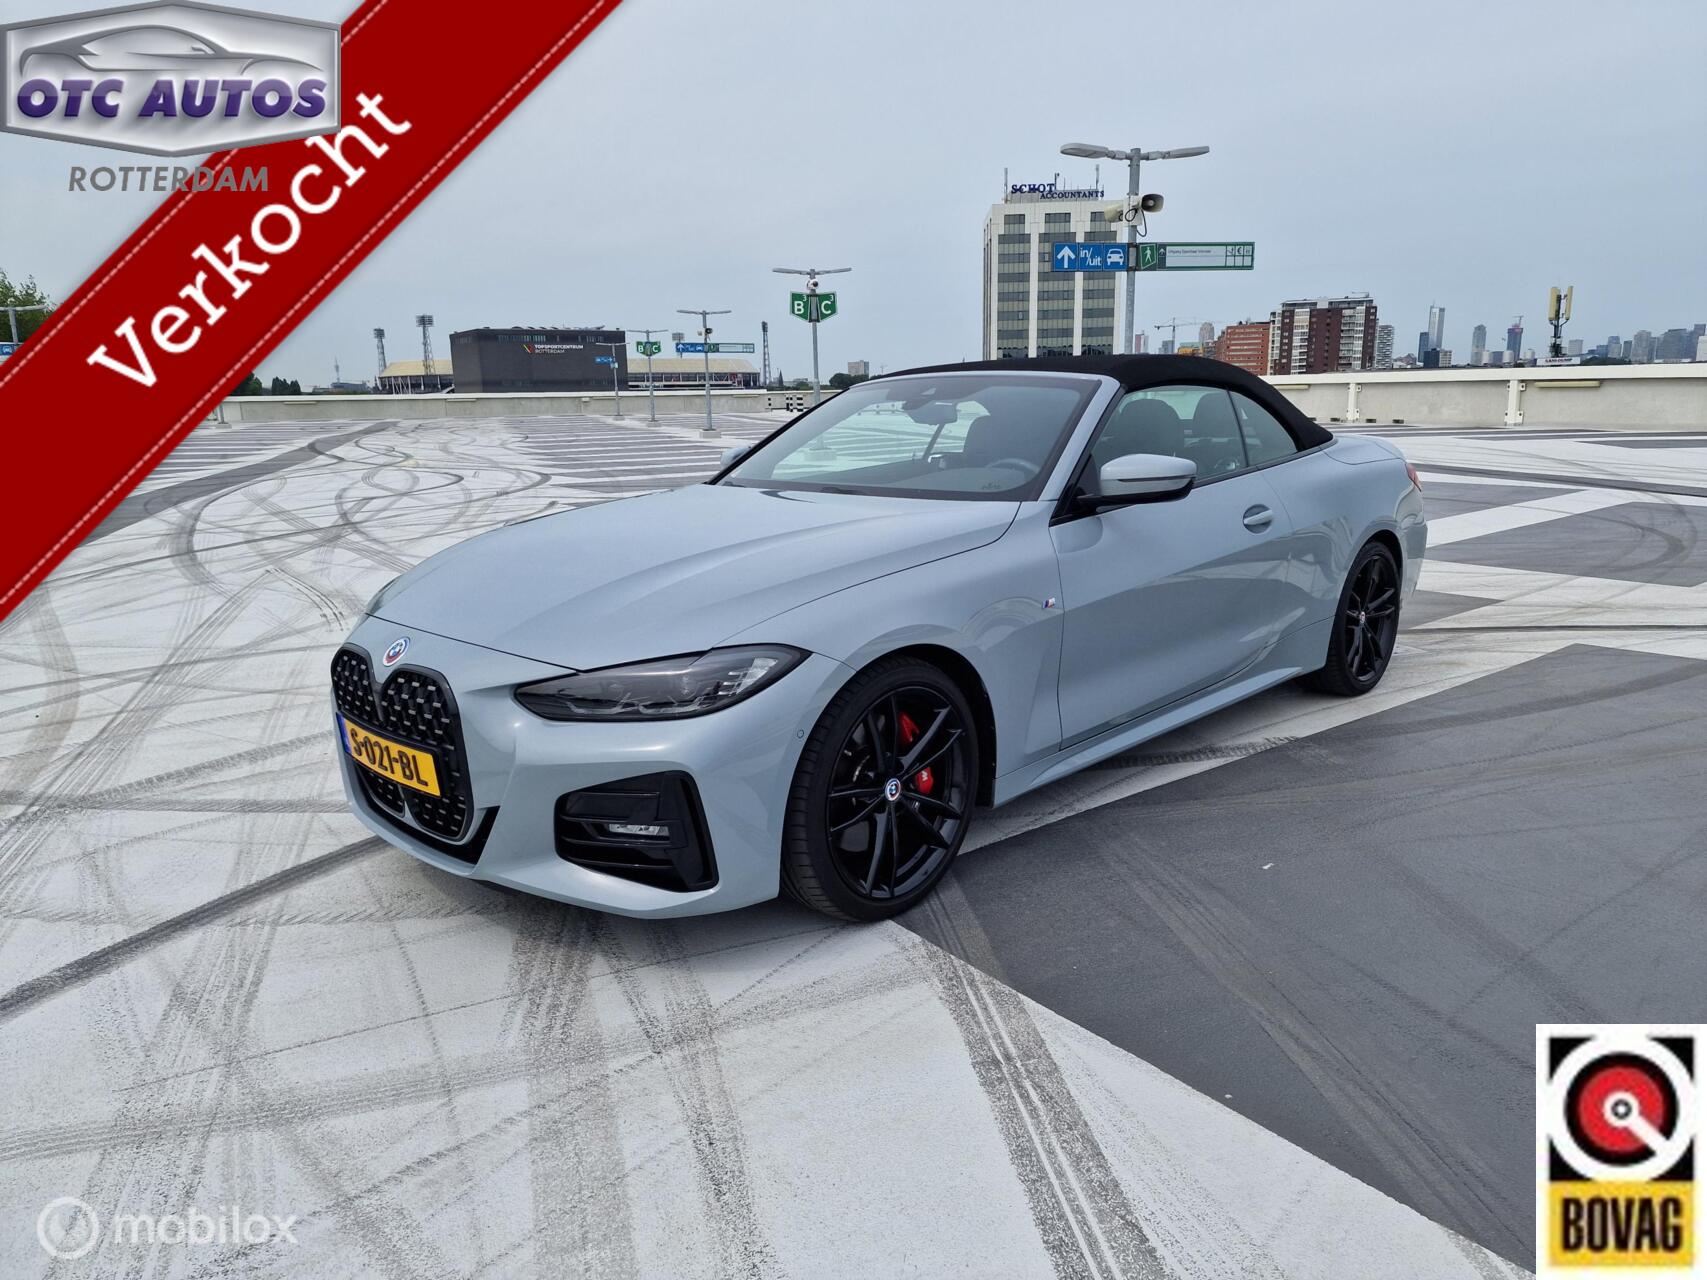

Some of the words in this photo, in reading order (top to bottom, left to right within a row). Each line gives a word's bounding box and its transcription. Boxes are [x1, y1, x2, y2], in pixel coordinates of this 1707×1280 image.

[1011, 183, 1055, 194] SCHOT
[1040, 190, 1104, 200] ACCOUNTANTS
[794, 300, 805, 315] B
[821, 300, 832, 315] C
[350, 728, 428, 786] S-021-BL
